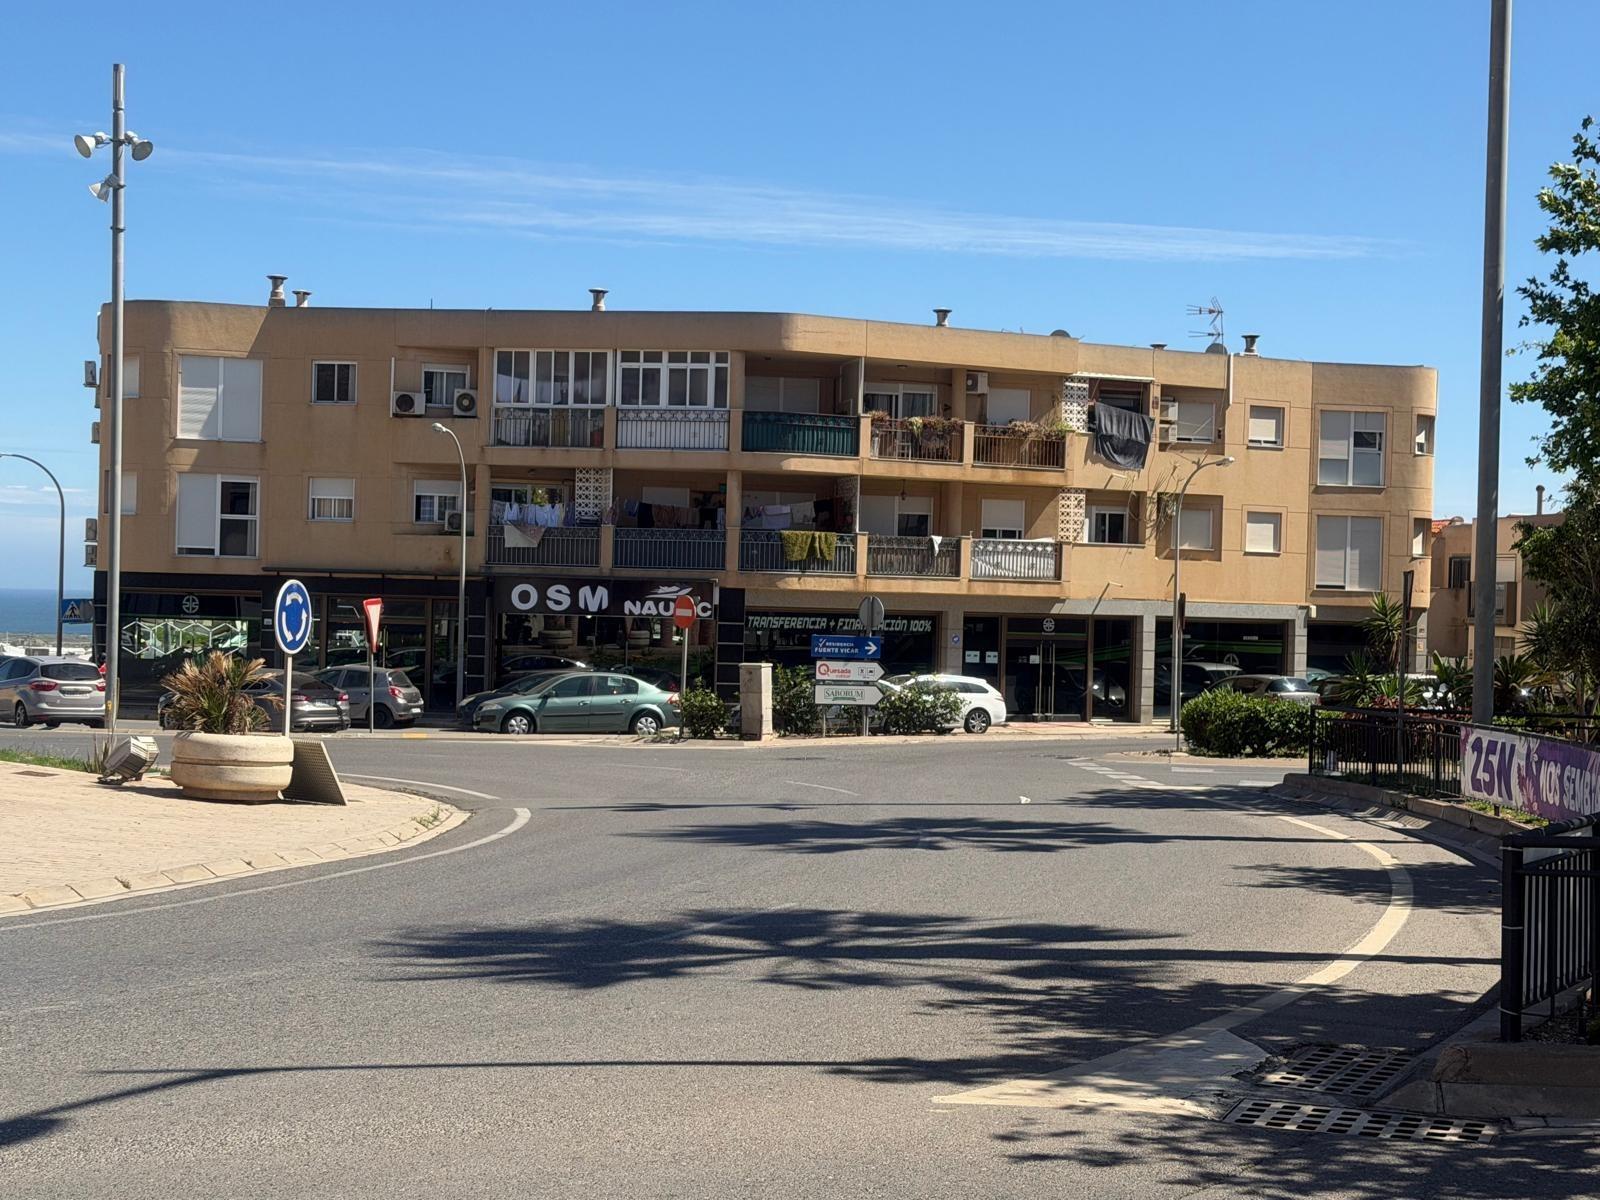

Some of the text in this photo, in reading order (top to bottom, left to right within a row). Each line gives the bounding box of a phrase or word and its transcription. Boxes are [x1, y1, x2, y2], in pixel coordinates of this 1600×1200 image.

[511, 583, 712, 617] OSM NAUC
[748, 616, 827, 629] TRANSFERENCIA
[909, 619, 932, 632] 100%
[818, 663, 852, 677] Quesada
[825, 690, 864, 698] SABORUM
[1470, 736, 1516, 802] 25N
[1540, 760, 1560, 807] NOS
